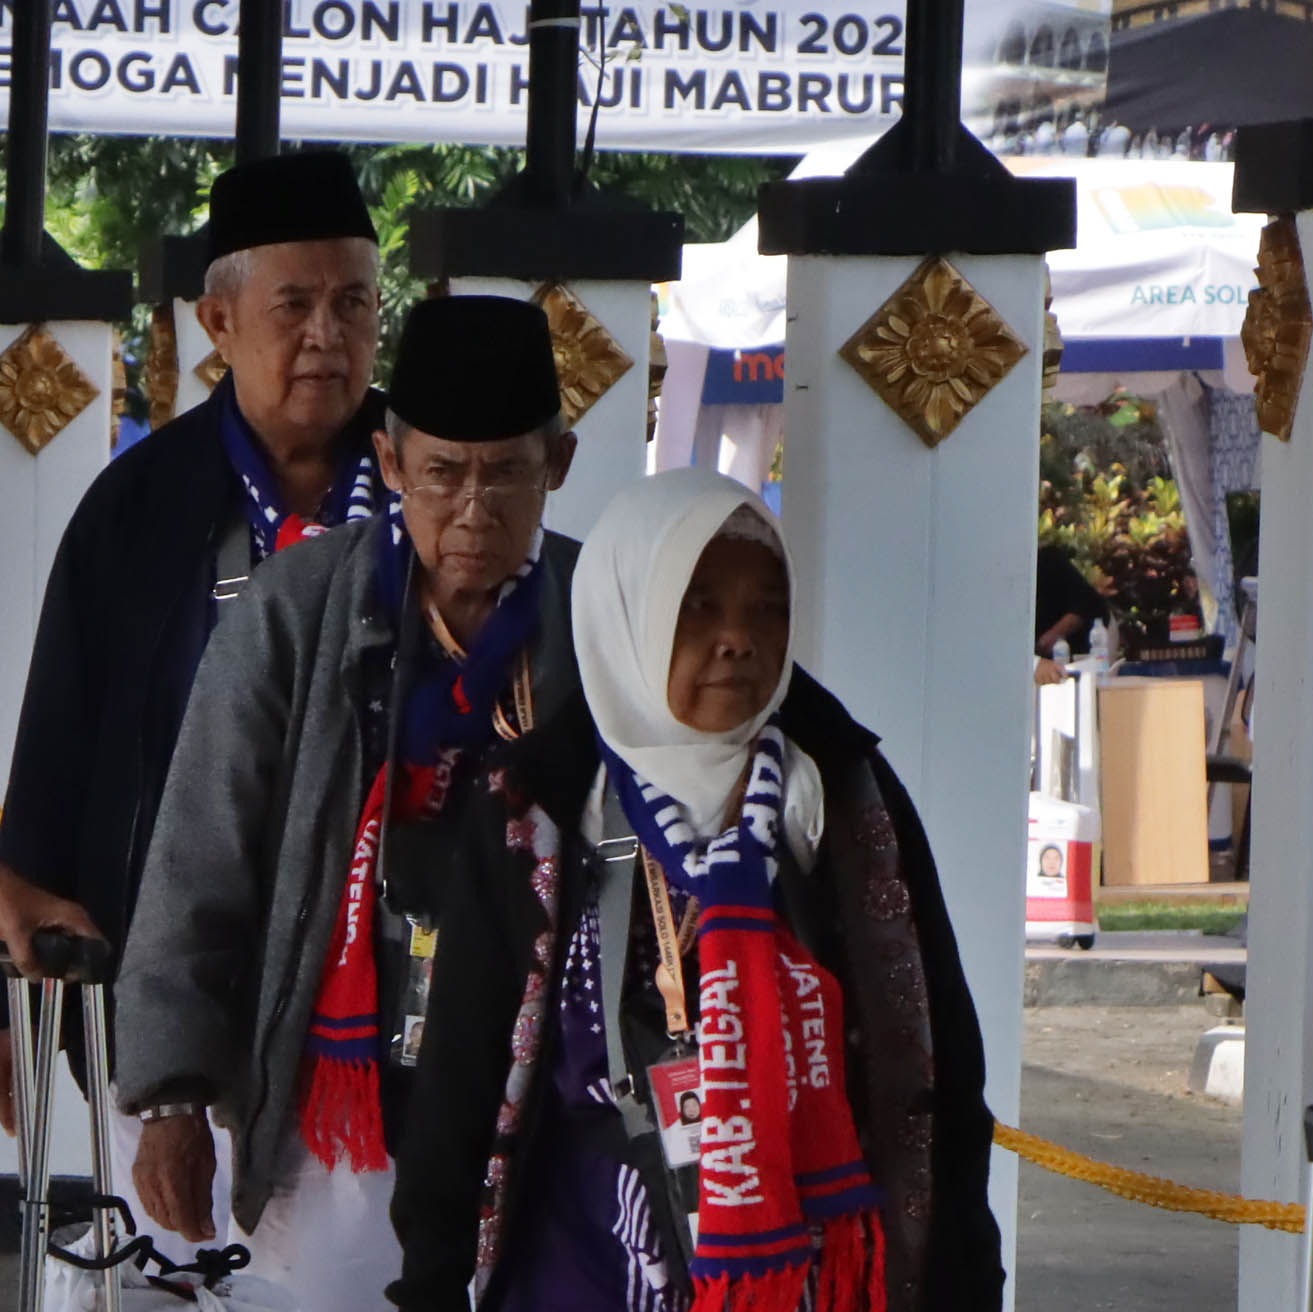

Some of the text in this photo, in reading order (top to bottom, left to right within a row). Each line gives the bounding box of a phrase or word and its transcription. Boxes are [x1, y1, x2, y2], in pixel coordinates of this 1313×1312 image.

[192, 0, 399, 41] CLON
[422, 2, 531, 46] HAJ
[581, 9, 777, 53] TAHUN
[797, 14, 904, 56] 202
[510, 66, 641, 108] HJI
[1130, 285, 1266, 305] AREA SOL
[656, 914, 670, 939] SOLO
[779, 953, 830, 1089] JATENG
